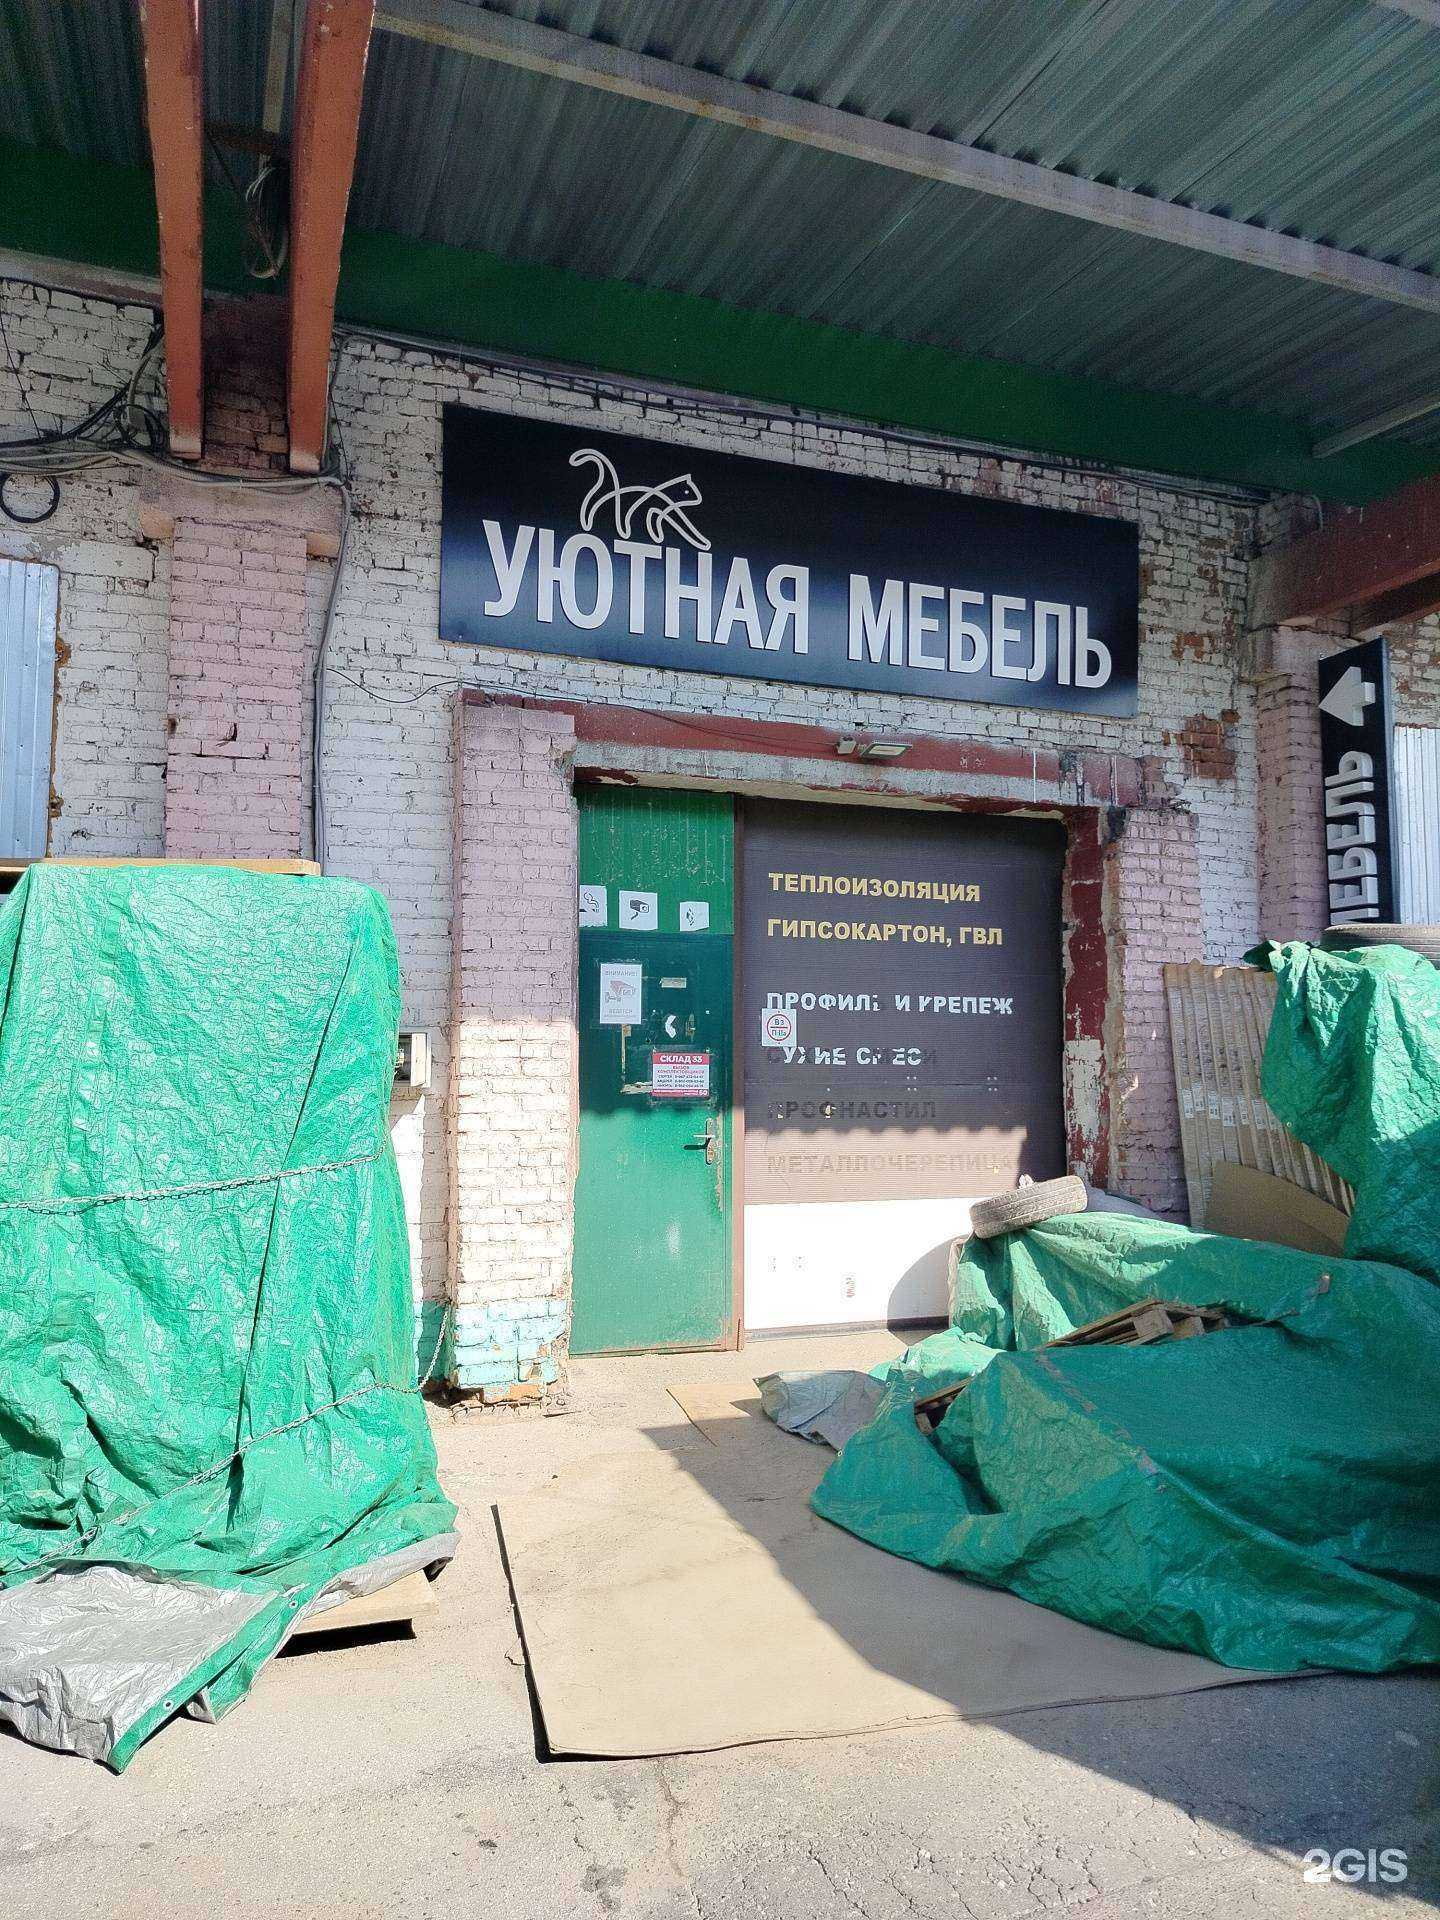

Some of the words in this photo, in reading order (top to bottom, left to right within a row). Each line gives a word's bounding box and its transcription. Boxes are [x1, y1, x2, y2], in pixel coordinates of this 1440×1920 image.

[482, 519, 810, 655] УЮТНАЯ
[848, 573, 1113, 690] МЕБЕЛЬ
[768, 872, 981, 903] ТЕПЛОИЗОЛЯЦИЯ
[767, 918, 952, 948] ГИПСОКАРТОН,
[959, 926, 1003, 945] ГВЛ
[894, 994, 911, 1012] И
[918, 995, 1014, 1015] КРЕПЕЖ
[660, 1055, 691, 1064] СКЛАД
